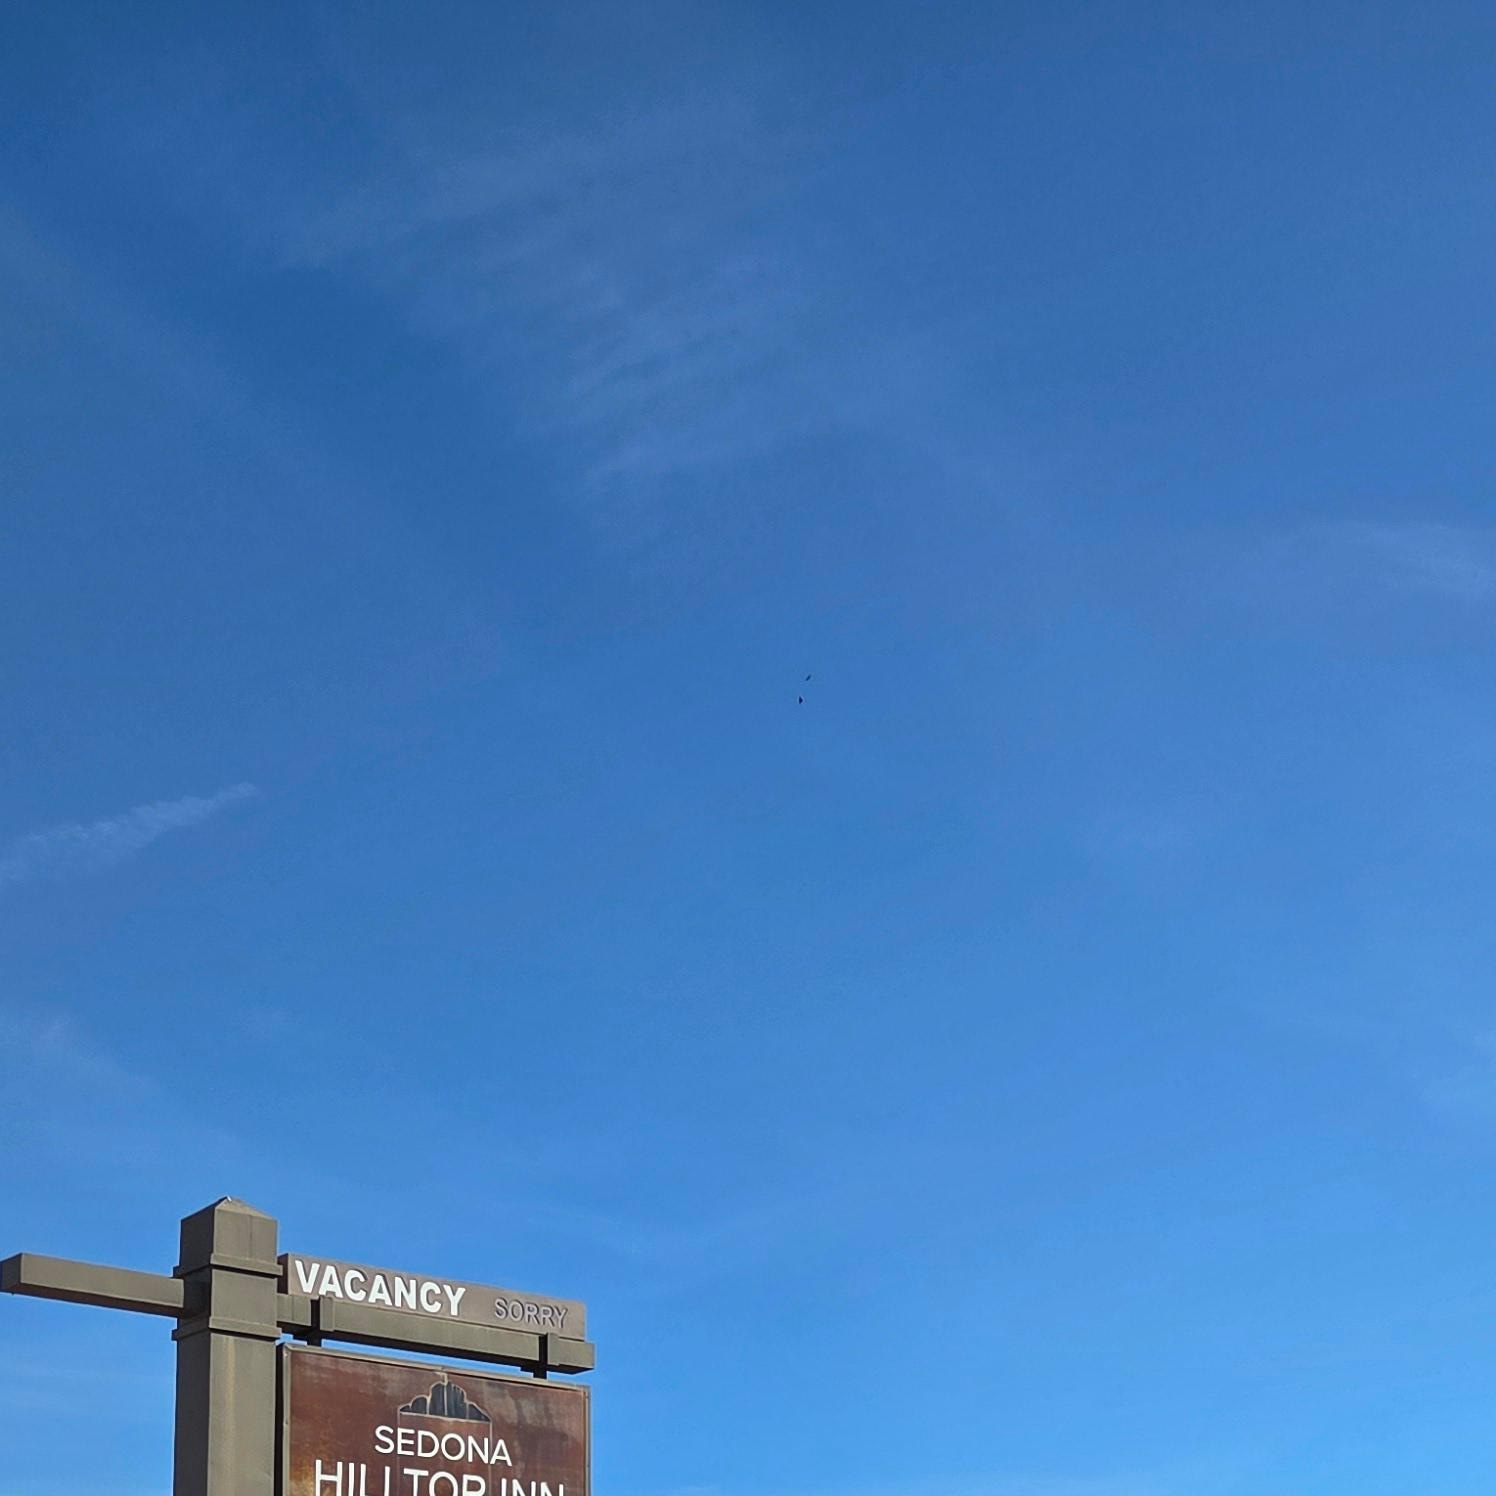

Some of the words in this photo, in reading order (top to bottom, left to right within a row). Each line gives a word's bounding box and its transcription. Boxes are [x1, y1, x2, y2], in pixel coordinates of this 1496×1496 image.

[294, 1259, 466, 1317] VACANCY
[494, 1298, 568, 1329] SORRY
[374, 1424, 513, 1468] SEDONA
